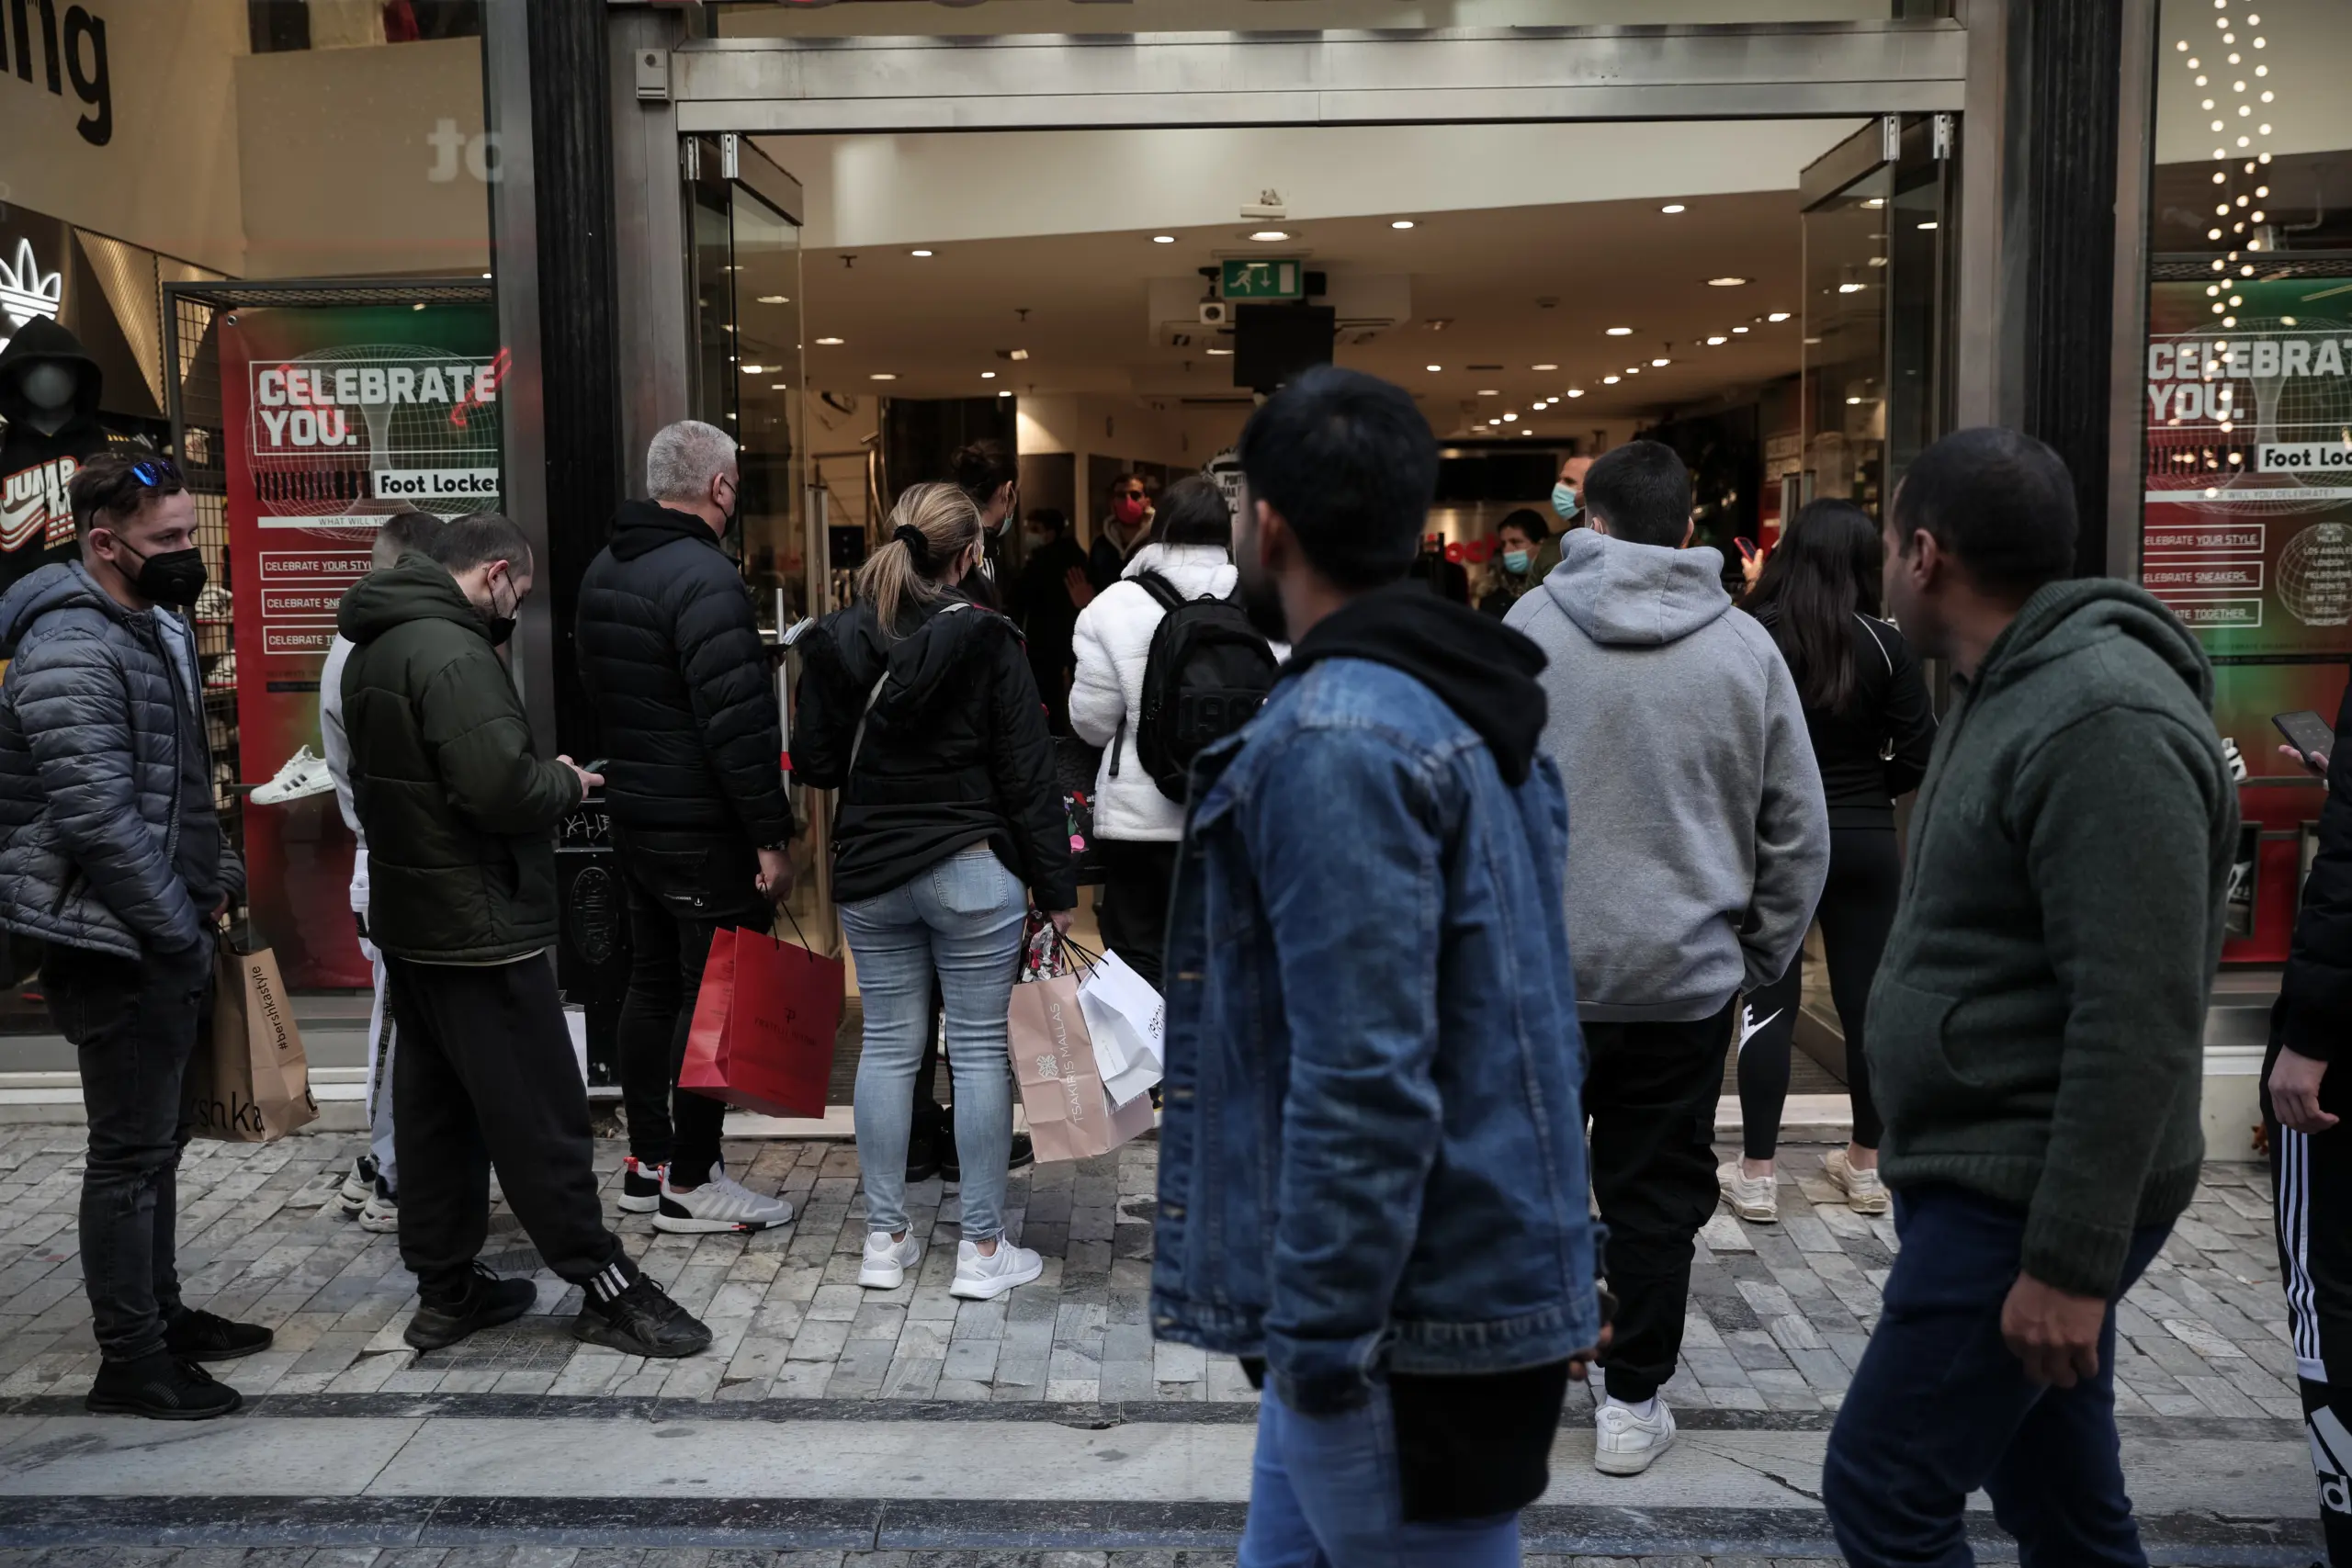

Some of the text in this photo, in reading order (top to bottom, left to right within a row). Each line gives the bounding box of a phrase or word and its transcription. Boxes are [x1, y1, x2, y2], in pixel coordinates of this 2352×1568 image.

[2148, 339, 2352, 380] CELEBRA
[259, 366, 496, 406] CELEBRATE
[2148, 382, 2245, 421] YOU.
[259, 410, 357, 446] YOU.
[2265, 447, 2352, 467] Foot Loc
[380, 473, 499, 493] Foot Locke
[2229, 491, 2250, 499] WILL
[2254, 490, 2273, 499] YOU
[318, 516, 345, 526] WHAT
[348, 516, 370, 525] WILL
[2144, 534, 2194, 546] ELEBRATE
[2196, 535, 2224, 546] YOUR
[2316, 535, 2343, 543] MILAN
[2303, 547, 2352, 556] LOS ANGELE
[265, 559, 372, 571] CELEBRATE YOUR STYL
[2312, 558, 2345, 567] LONDON
[2143, 571, 2193, 583] ELEBRATE
[2304, 570, 2352, 579] MELBOURNE
[2310, 582, 2346, 591] TORONTO
[266, 597, 322, 608] CELEBRATE
[268, 635, 323, 646] CELEBRATE
[252, 965, 288, 1051] #bershkastyle
[1049, 1003, 1084, 1123] TSAKIRIS MALLAS
